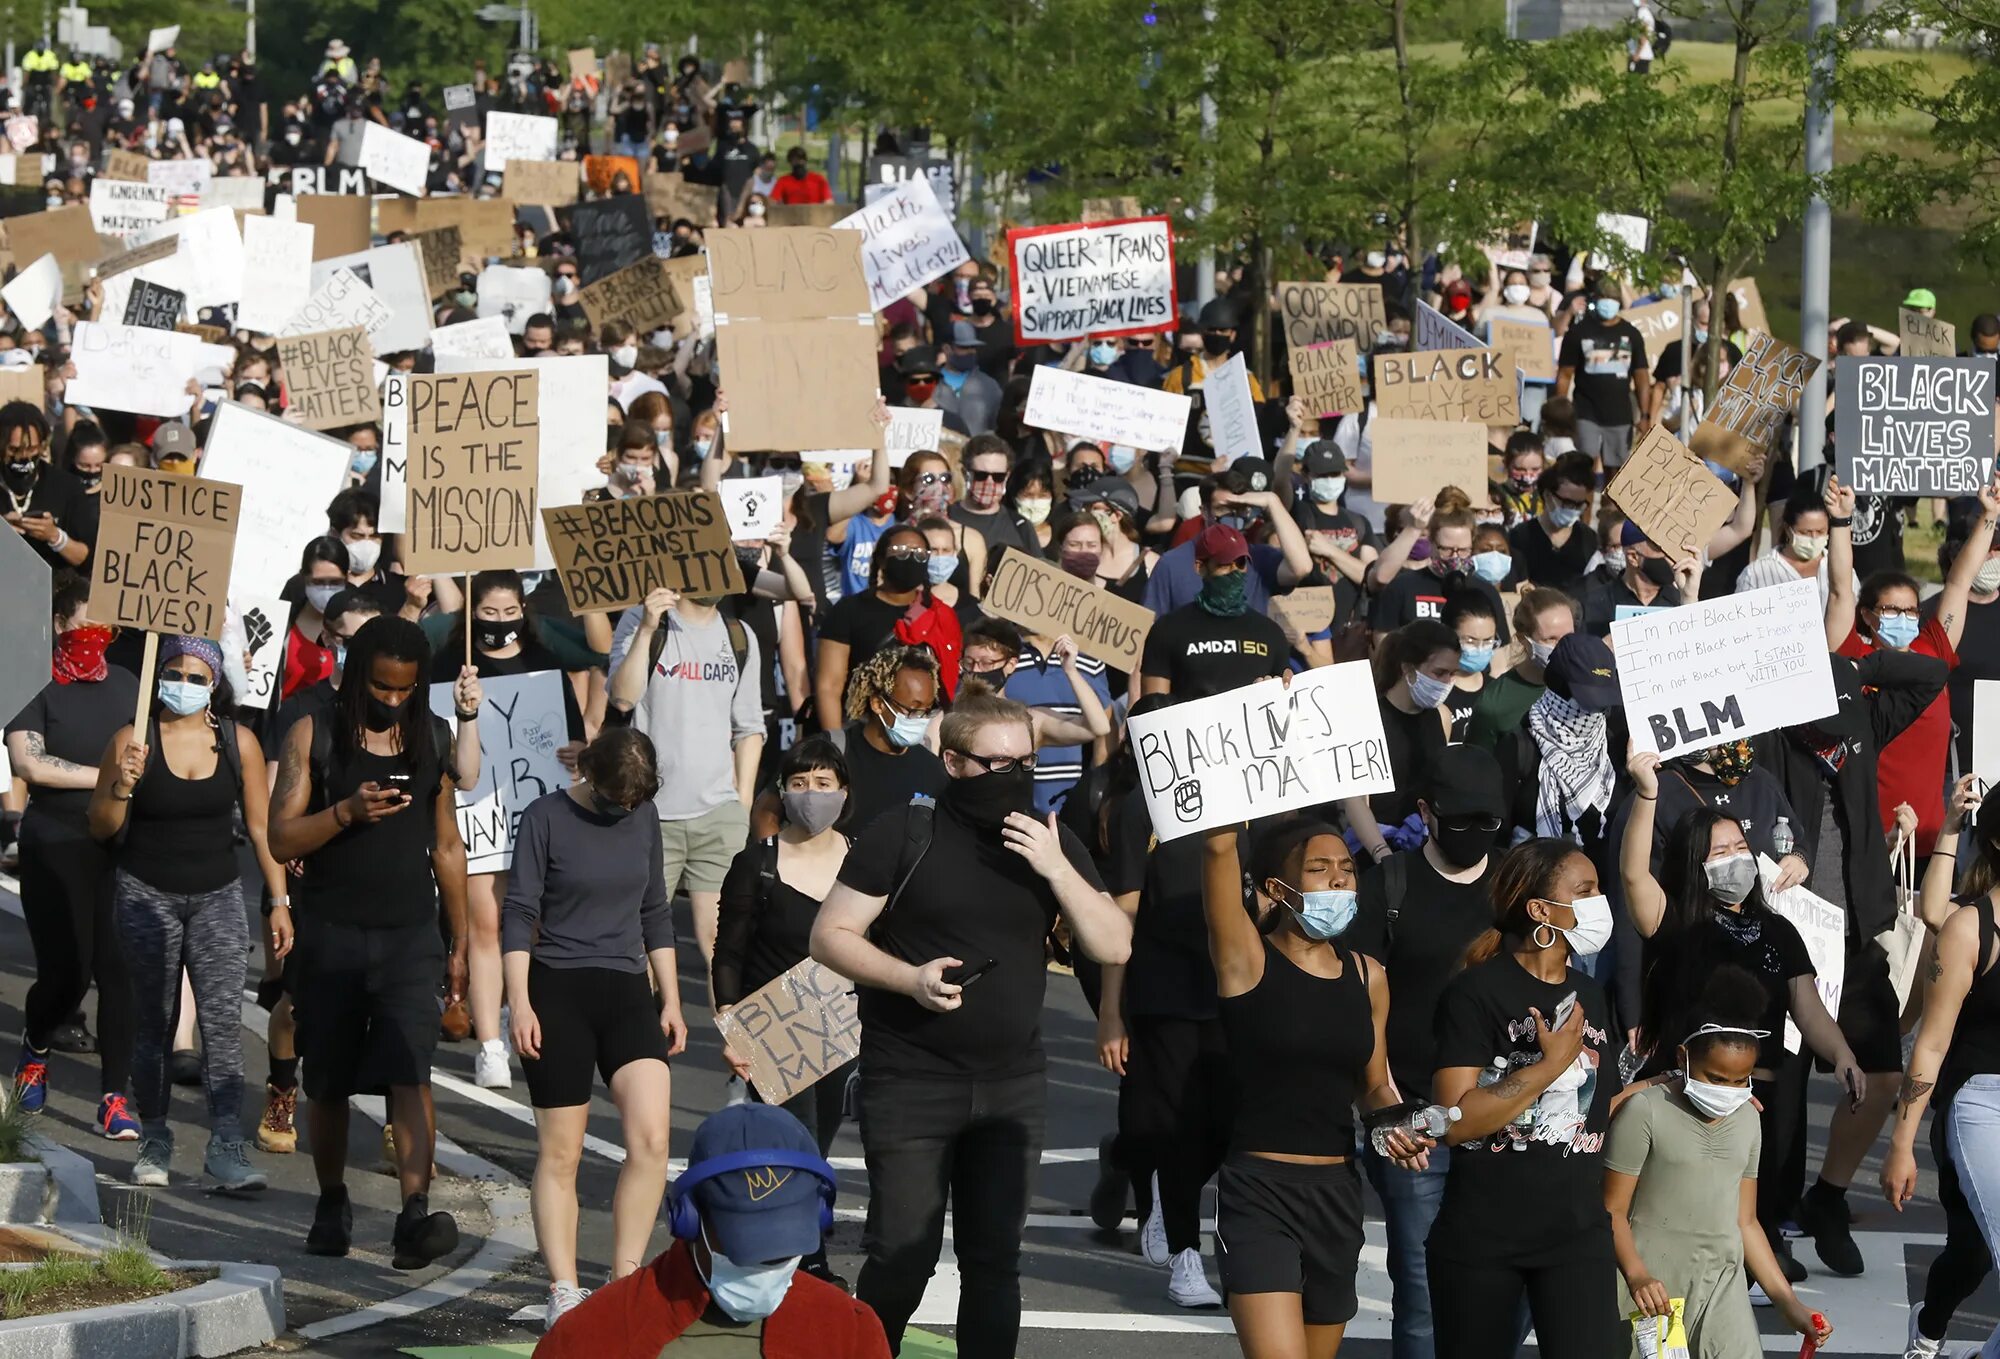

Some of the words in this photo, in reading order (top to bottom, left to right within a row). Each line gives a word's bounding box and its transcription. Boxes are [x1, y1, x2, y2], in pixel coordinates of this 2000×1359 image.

[869, 231, 931, 271] Lives
[1023, 237, 1097, 274] QUEER
[1104, 233, 1166, 268] TRANS
[1042, 268, 1141, 304] VIETNAMESE
[1285, 284, 1340, 319] COPS
[1344, 286, 1380, 313] OFF
[1023, 306, 1087, 333] SUPPORT
[1086, 297, 1125, 328] BLACK
[1127, 295, 1166, 322] LIVES
[1905, 314, 1952, 348] BLACK
[281, 332, 367, 368] #BLACK
[1289, 319, 1387, 352] CAMPUS
[286, 358, 366, 393] LIVES
[1295, 344, 1348, 375] BLACK
[1383, 351, 1504, 386] BLACK
[1741, 332, 1816, 388] BLACK
[288, 384, 374, 420] MATTER
[411, 373, 538, 434] PEACE
[1301, 386, 1359, 419] MATTER
[1302, 370, 1347, 396] LIVES
[1408, 382, 1498, 404] LIVES
[1725, 362, 1804, 413] LIVES
[1857, 363, 1990, 416] BLACK
[1714, 387, 1785, 447] MATTER
[423, 444, 445, 480] IS
[461, 440, 522, 474] THE
[1646, 435, 1718, 506] BLACK
[1852, 455, 1993, 493] MATTER!
[103, 472, 232, 522] JUSTICE
[1640, 464, 1704, 528] LIVES
[411, 486, 534, 554] MISSION
[554, 494, 715, 541] #BEACONS
[134, 522, 194, 563] FOR
[572, 529, 700, 566] AGAINST
[102, 550, 209, 597] BLACK
[566, 549, 733, 608] BRUTALITY
[1788, 583, 1814, 597] see
[117, 590, 213, 637] LIVES!
[991, 557, 1042, 617] COPS
[1070, 593, 1142, 656] CAMPUS
[1613, 619, 1660, 648] I'm
[1668, 612, 1700, 636] not
[1703, 604, 1747, 628] Black
[1750, 597, 1776, 617] but
[1786, 599, 1809, 615] you
[1186, 640, 1223, 656] AMD
[1243, 640, 1268, 656] 50
[1618, 647, 1664, 675] I'm
[1667, 645, 1692, 663] not
[1695, 637, 1728, 657] Black
[1733, 631, 1754, 646] but
[1766, 624, 1793, 638] hear
[1797, 618, 1818, 636] you
[680, 662, 702, 680] ALL
[703, 663, 735, 683] CAPS
[1625, 678, 1665, 704] I'm
[1670, 674, 1688, 690] not
[1693, 666, 1727, 683] Black
[1728, 661, 1748, 675] but
[1753, 650, 1765, 666] I
[1764, 641, 1805, 663] STAND
[1745, 666, 1779, 684] WITH
[1139, 721, 1241, 799] BLACK
[1243, 685, 1332, 760] LIVES
[1647, 693, 1747, 755] BLM
[734, 963, 841, 1040] BLAC
[760, 997, 856, 1066] LIVE
